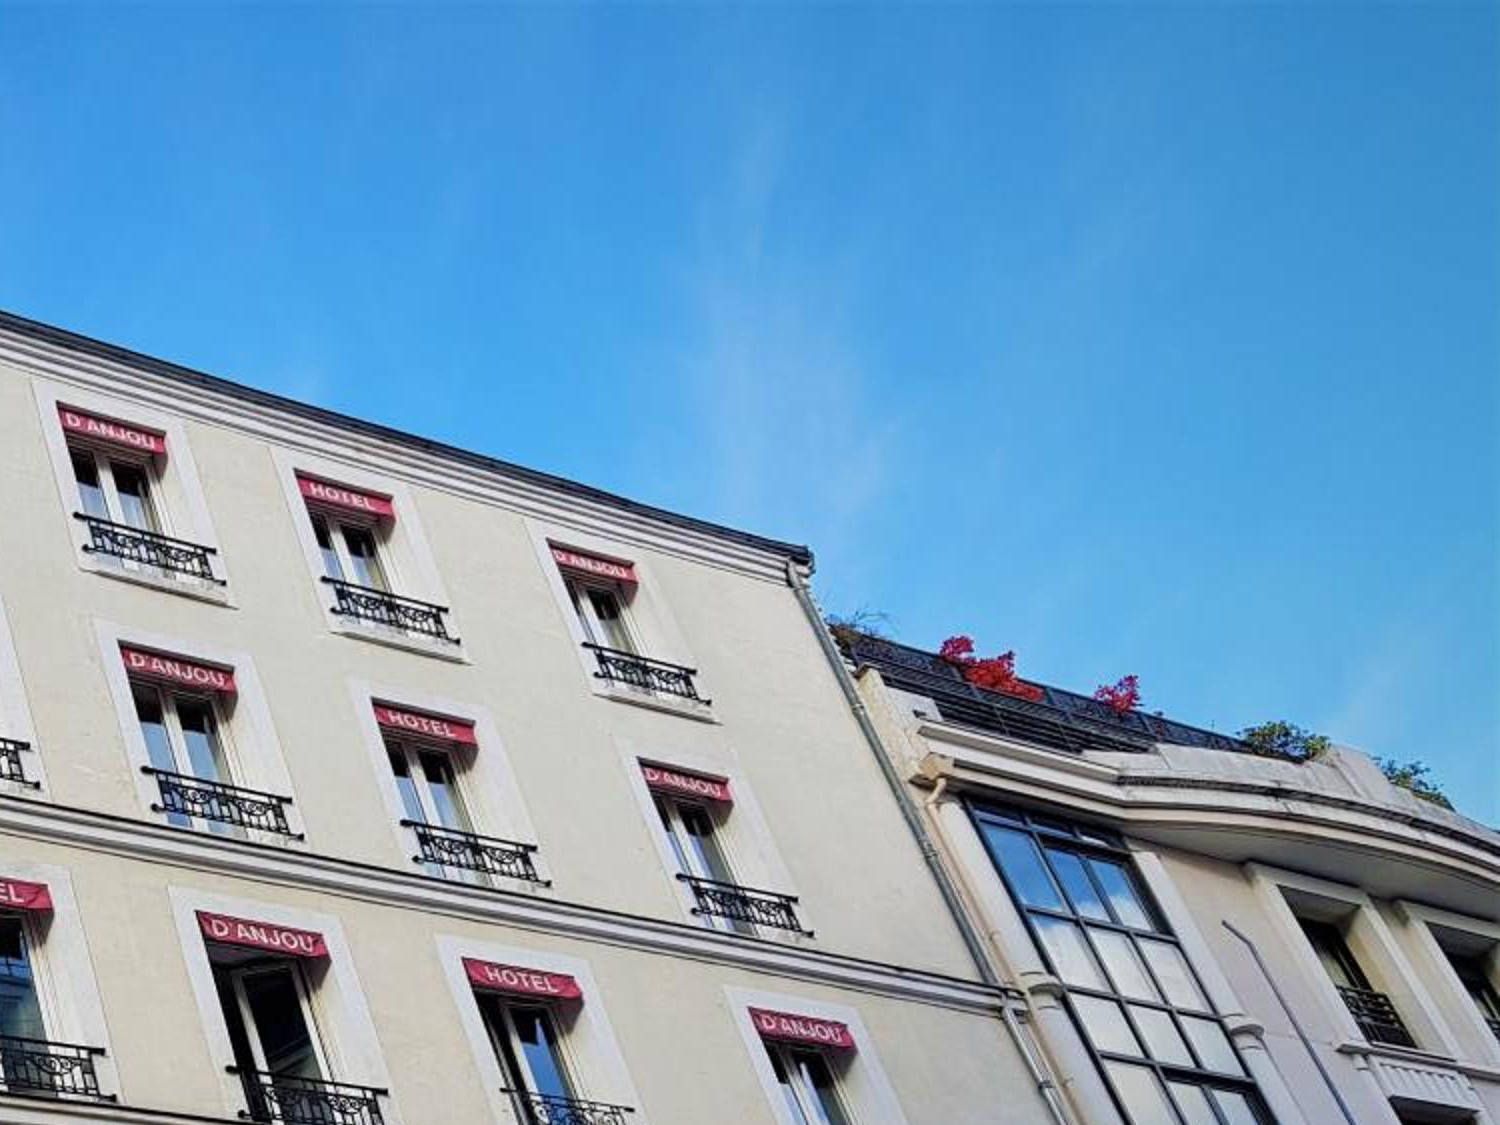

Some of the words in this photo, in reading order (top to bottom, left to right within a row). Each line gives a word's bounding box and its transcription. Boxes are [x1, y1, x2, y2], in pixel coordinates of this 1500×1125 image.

[310, 483, 377, 512] HOTEL
[130, 653, 224, 687] D'ANJOU
[388, 710, 456, 738] HOTEL
[646, 768, 721, 797] D'ANJOU
[212, 920, 313, 952] D'ANJOU
[485, 966, 560, 993] HOTEL
[761, 1014, 840, 1043] D'ANJOU
